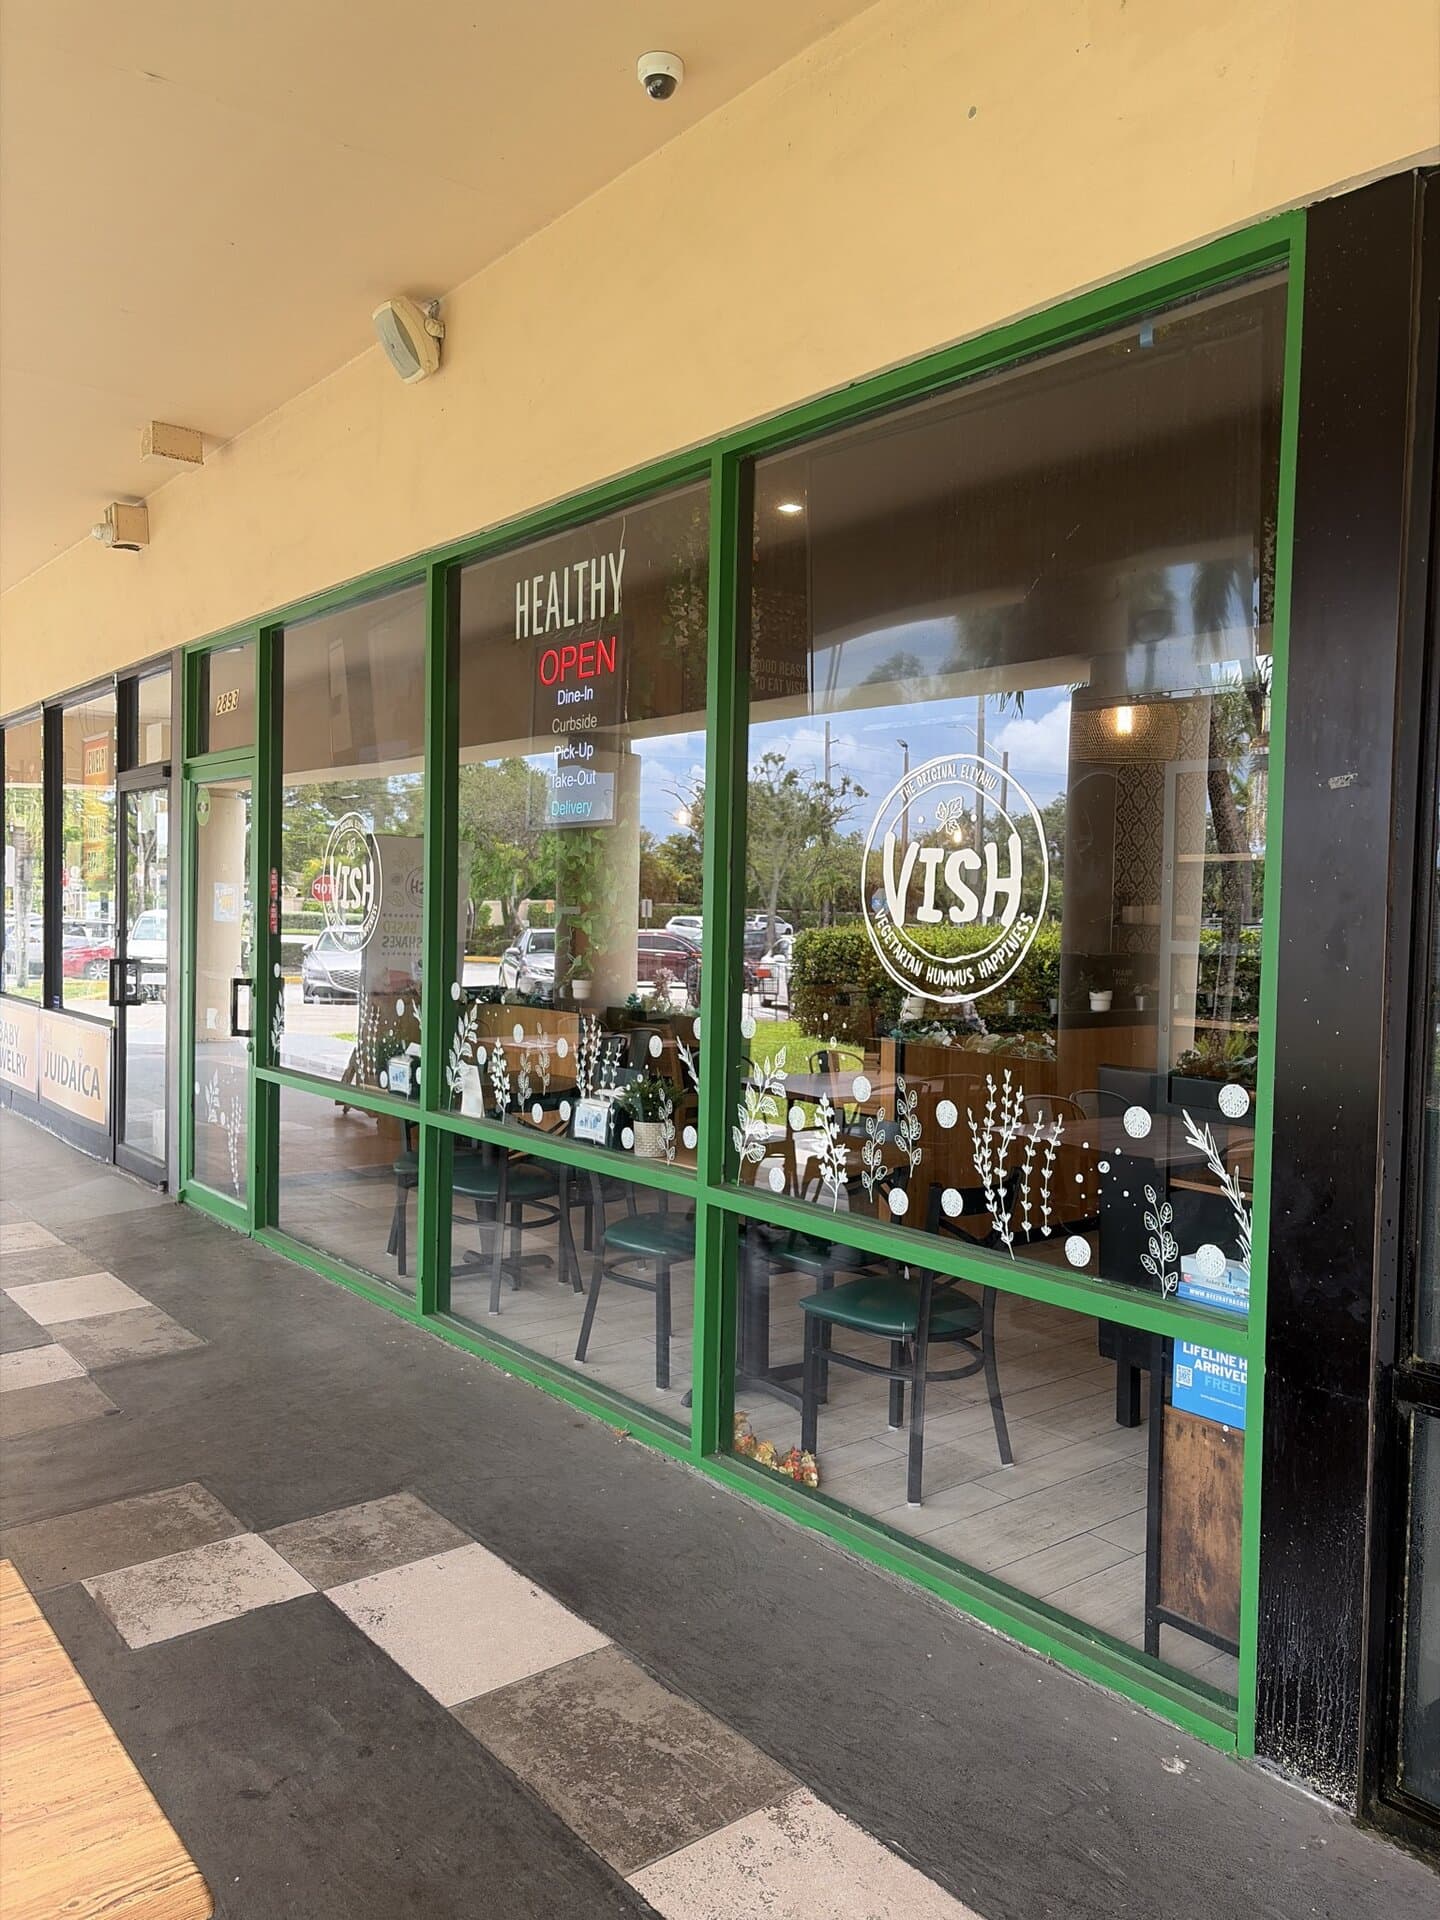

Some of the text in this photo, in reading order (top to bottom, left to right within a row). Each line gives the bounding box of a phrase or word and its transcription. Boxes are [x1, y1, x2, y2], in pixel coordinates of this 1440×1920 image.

[515, 549, 626, 640] HEALTHY
[539, 636, 616, 686] OPEN
[779, 661, 806, 678] REASO
[217, 690, 238, 714] 2893
[557, 685, 594, 706] Dine-In
[551, 714, 598, 734] Curbside
[553, 742, 594, 763] Pick-Up
[550, 769, 597, 790] Take-Out
[900, 764, 999, 801] THE ORIGINAL ELIYAHU
[551, 799, 593, 817] Delivery
[330, 856, 375, 912] VISH
[883, 831, 1023, 929] VISH
[873, 907, 1035, 986] VEGETARIAN HUMMUS HAPPINESS
[0, 1021, 20, 1049] BABY
[44, 1049, 101, 1101] JUIDAICA
[1182, 1341, 1248, 1371] LIFELINE H
[1194, 1358, 1248, 1385] ARRIVED
[1204, 1374, 1241, 1396] FREE!
